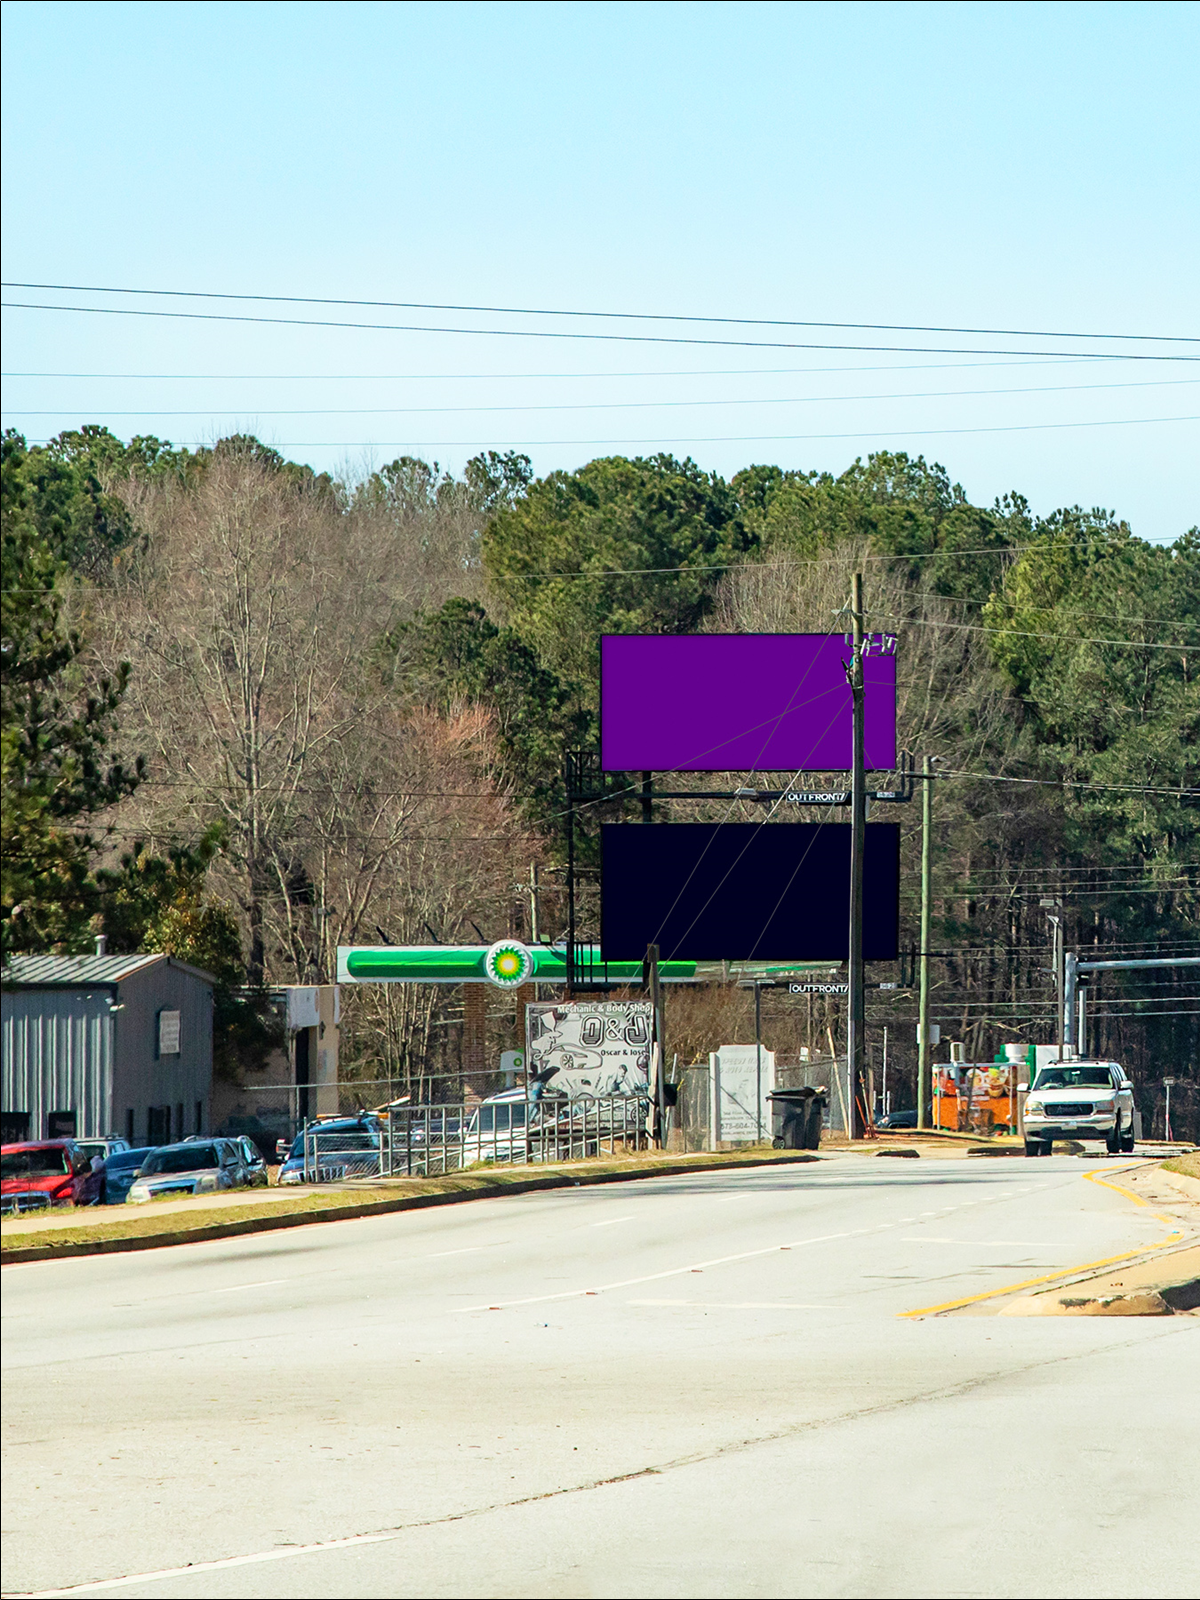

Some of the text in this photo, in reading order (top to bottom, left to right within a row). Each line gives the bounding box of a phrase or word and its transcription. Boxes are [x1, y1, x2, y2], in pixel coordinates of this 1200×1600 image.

[557, 1005, 595, 1013] Mechanic
[606, 1005, 627, 1013] Body
[629, 1004, 651, 1014] Shop
